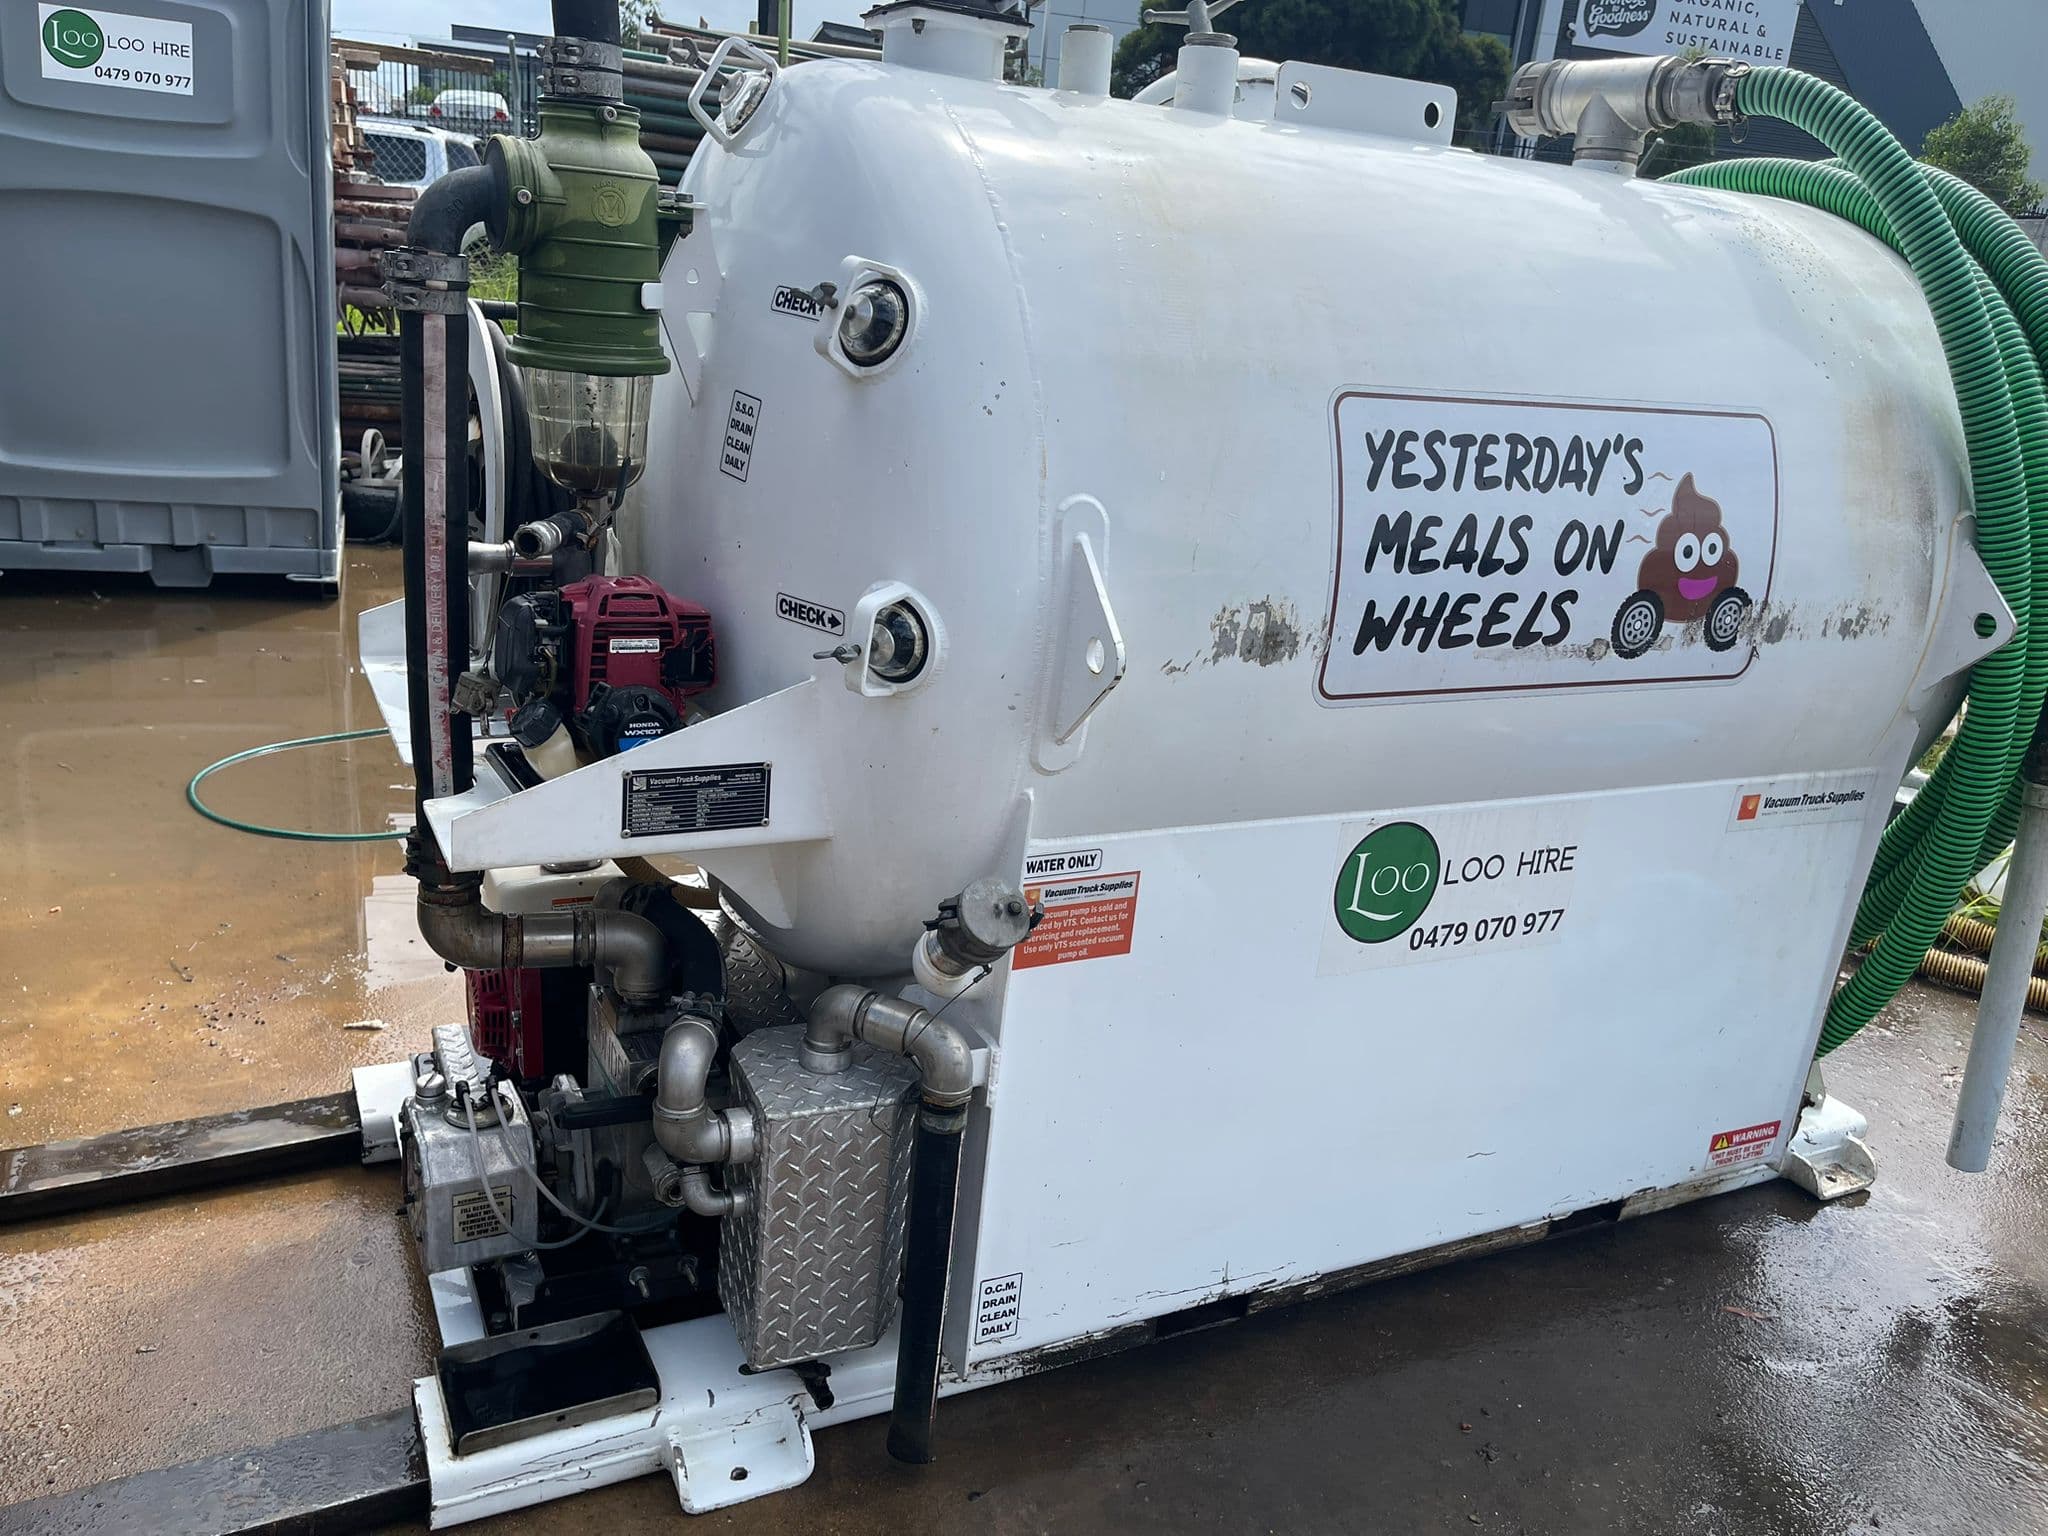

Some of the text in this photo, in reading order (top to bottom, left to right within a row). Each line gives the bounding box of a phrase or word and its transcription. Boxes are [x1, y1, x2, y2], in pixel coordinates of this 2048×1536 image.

[1589, 4, 1649, 33] Goodness
[1674, 0, 1759, 18] GANIC,
[1669, 11, 1767, 37] NATURAL &
[107, 35, 191, 58] LOO HIRE
[1665, 31, 1784, 60] SUSTAINABLE
[94, 66, 191, 89] 0479 070 977
[775, 291, 816, 315] CHECK
[730, 418, 753, 437] DRAIN
[726, 436, 750, 455] CLEAN
[725, 454, 745, 471] DAILY
[1364, 429, 1645, 496] YESTERDAY'S
[1363, 510, 1625, 578] MEALS ON
[430, 577, 442, 633] DELIVERY
[780, 598, 826, 627] CHECK
[1352, 588, 1579, 656] WHEELS
[629, 721, 660, 729] HONDA
[650, 777, 676, 786] Vacuum
[675, 775, 694, 784] Truck
[694, 773, 721, 784] Supplies
[1763, 790, 1865, 809] Vacuum Truck Supplies
[1026, 854, 1098, 874] WATER ONLY
[1443, 845, 1578, 886] LOO HIRE
[1044, 888, 1077, 898] Vacuum
[1077, 885, 1100, 895] Truck
[1099, 880, 1133, 892] Supplies
[1346, 852, 1431, 922] Loo
[1045, 901, 1128, 919] acuum pump is sold and
[1054, 919, 1063, 930] by
[1080, 914, 1108, 925] Contact
[1109, 912, 1118, 921] us
[1118, 911, 1129, 921] for
[1409, 908, 1565, 951] 0479 070 977
[1060, 929, 1074, 939] and
[1075, 923, 1121, 937] replacement.
[1023, 933, 1125, 955] Use only VTS scented vacuum
[1057, 950, 1077, 961] pump
[1732, 1126, 1775, 1143] WARNING
[984, 1281, 1017, 1295] O.C.M.
[983, 1294, 1016, 1309] DRAIN
[980, 1308, 1016, 1323] CLEAN
[981, 1321, 1012, 1336] DAILY
